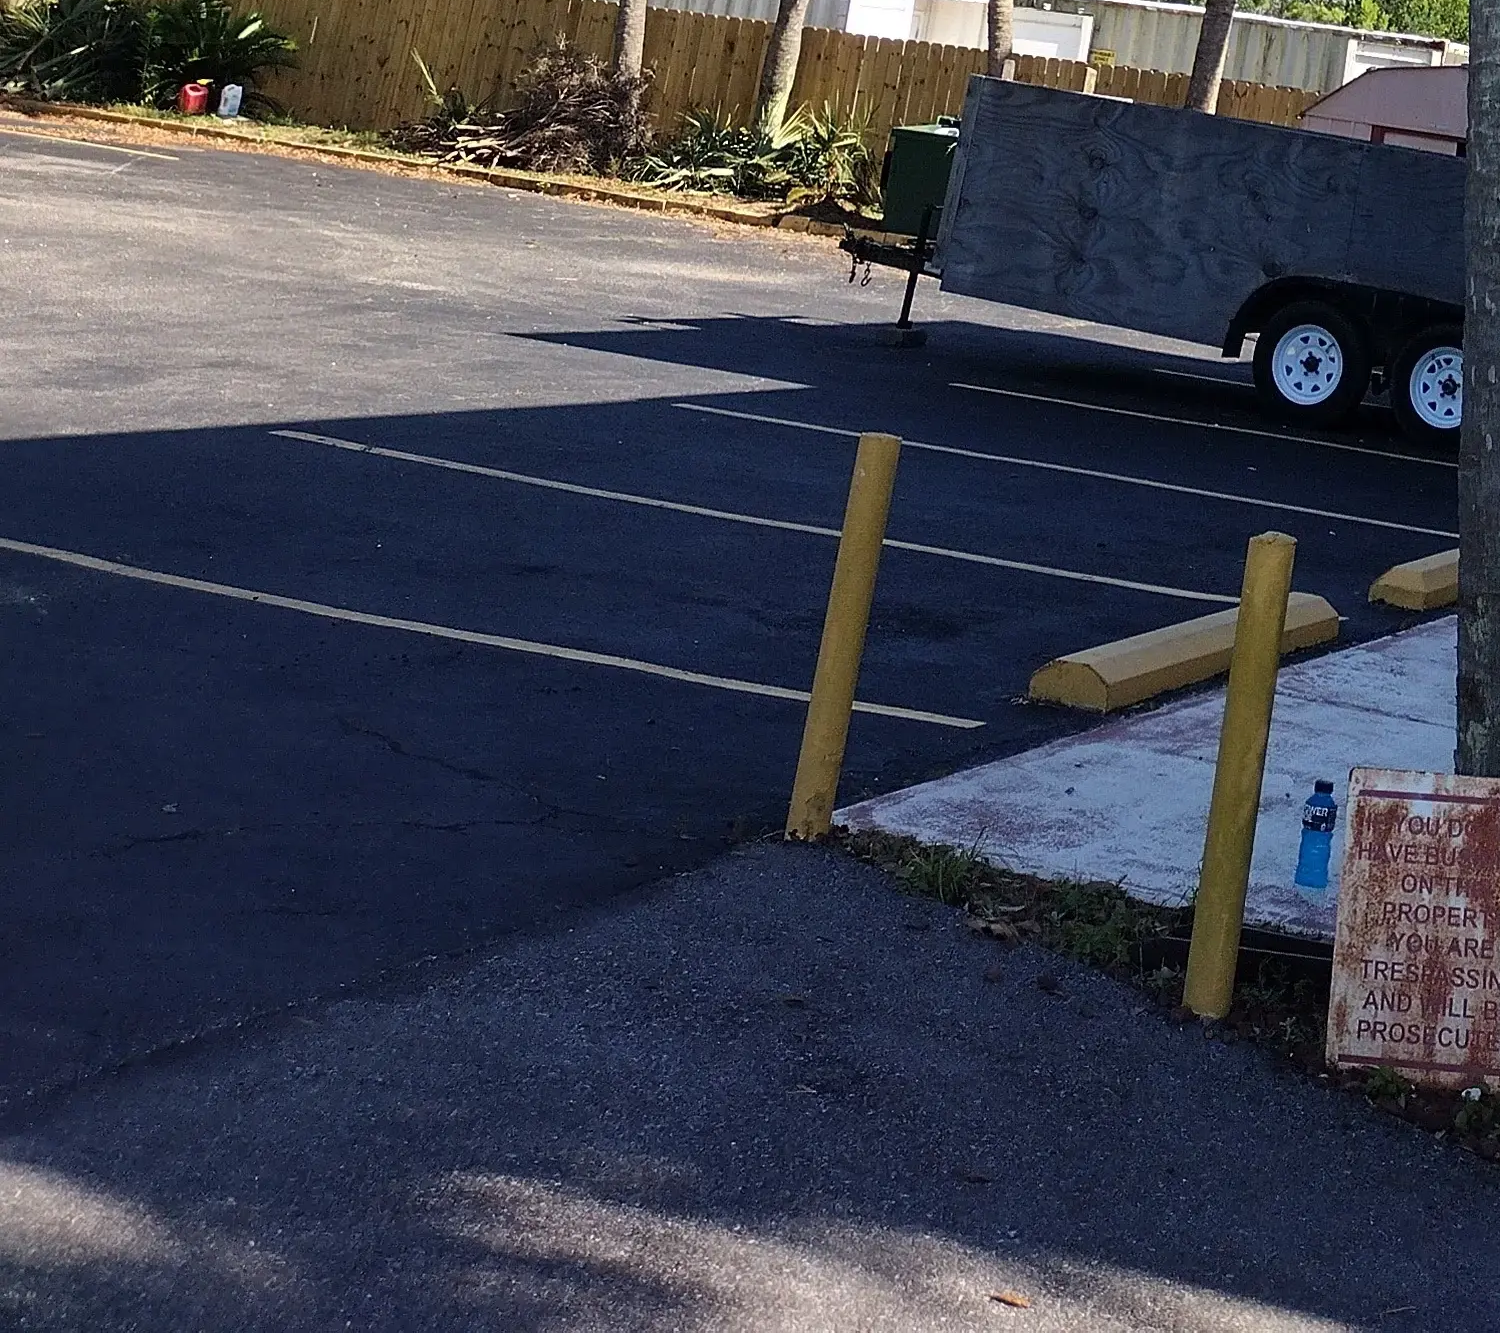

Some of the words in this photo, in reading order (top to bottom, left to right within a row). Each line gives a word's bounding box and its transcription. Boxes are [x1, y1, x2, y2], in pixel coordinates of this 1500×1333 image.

[1393, 810, 1440, 836] YOU
[1358, 841, 1418, 864] HAVE
[1401, 874, 1433, 895] ON
[1386, 933, 1439, 954] YOU
[1448, 937, 1494, 959] ARE
[1362, 990, 1412, 1013] AND
